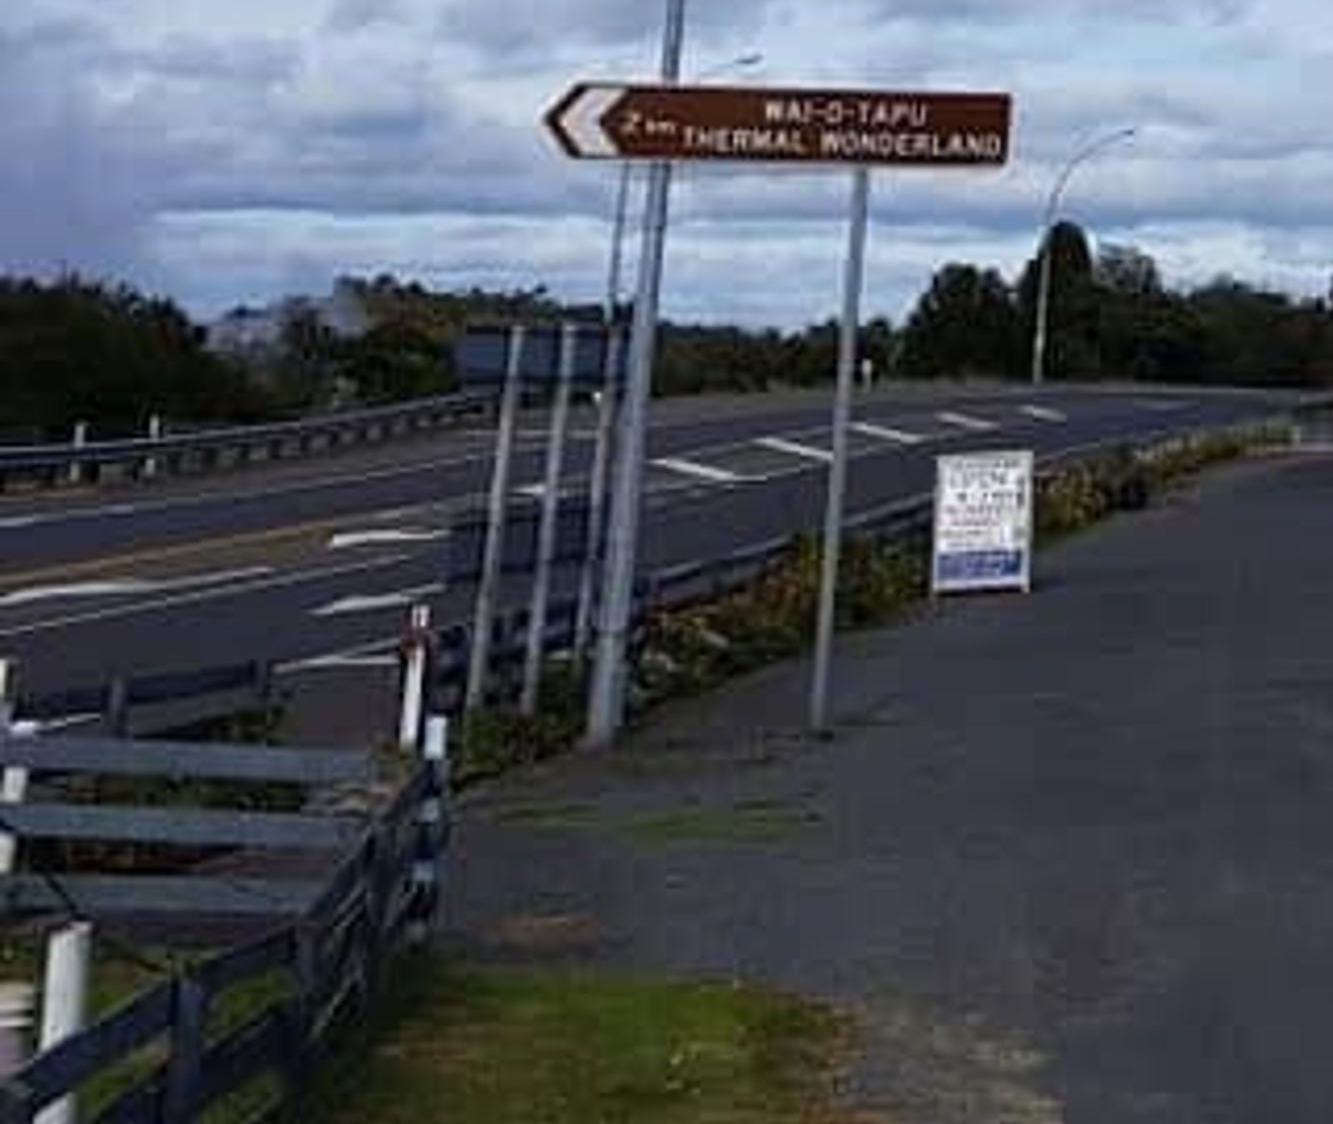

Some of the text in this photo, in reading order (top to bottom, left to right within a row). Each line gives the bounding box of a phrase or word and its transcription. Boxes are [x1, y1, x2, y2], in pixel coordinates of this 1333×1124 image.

[765, 100, 927, 125] WAI-O-TAPU
[682, 126, 1001, 156] THERMAL WONDERLAND
